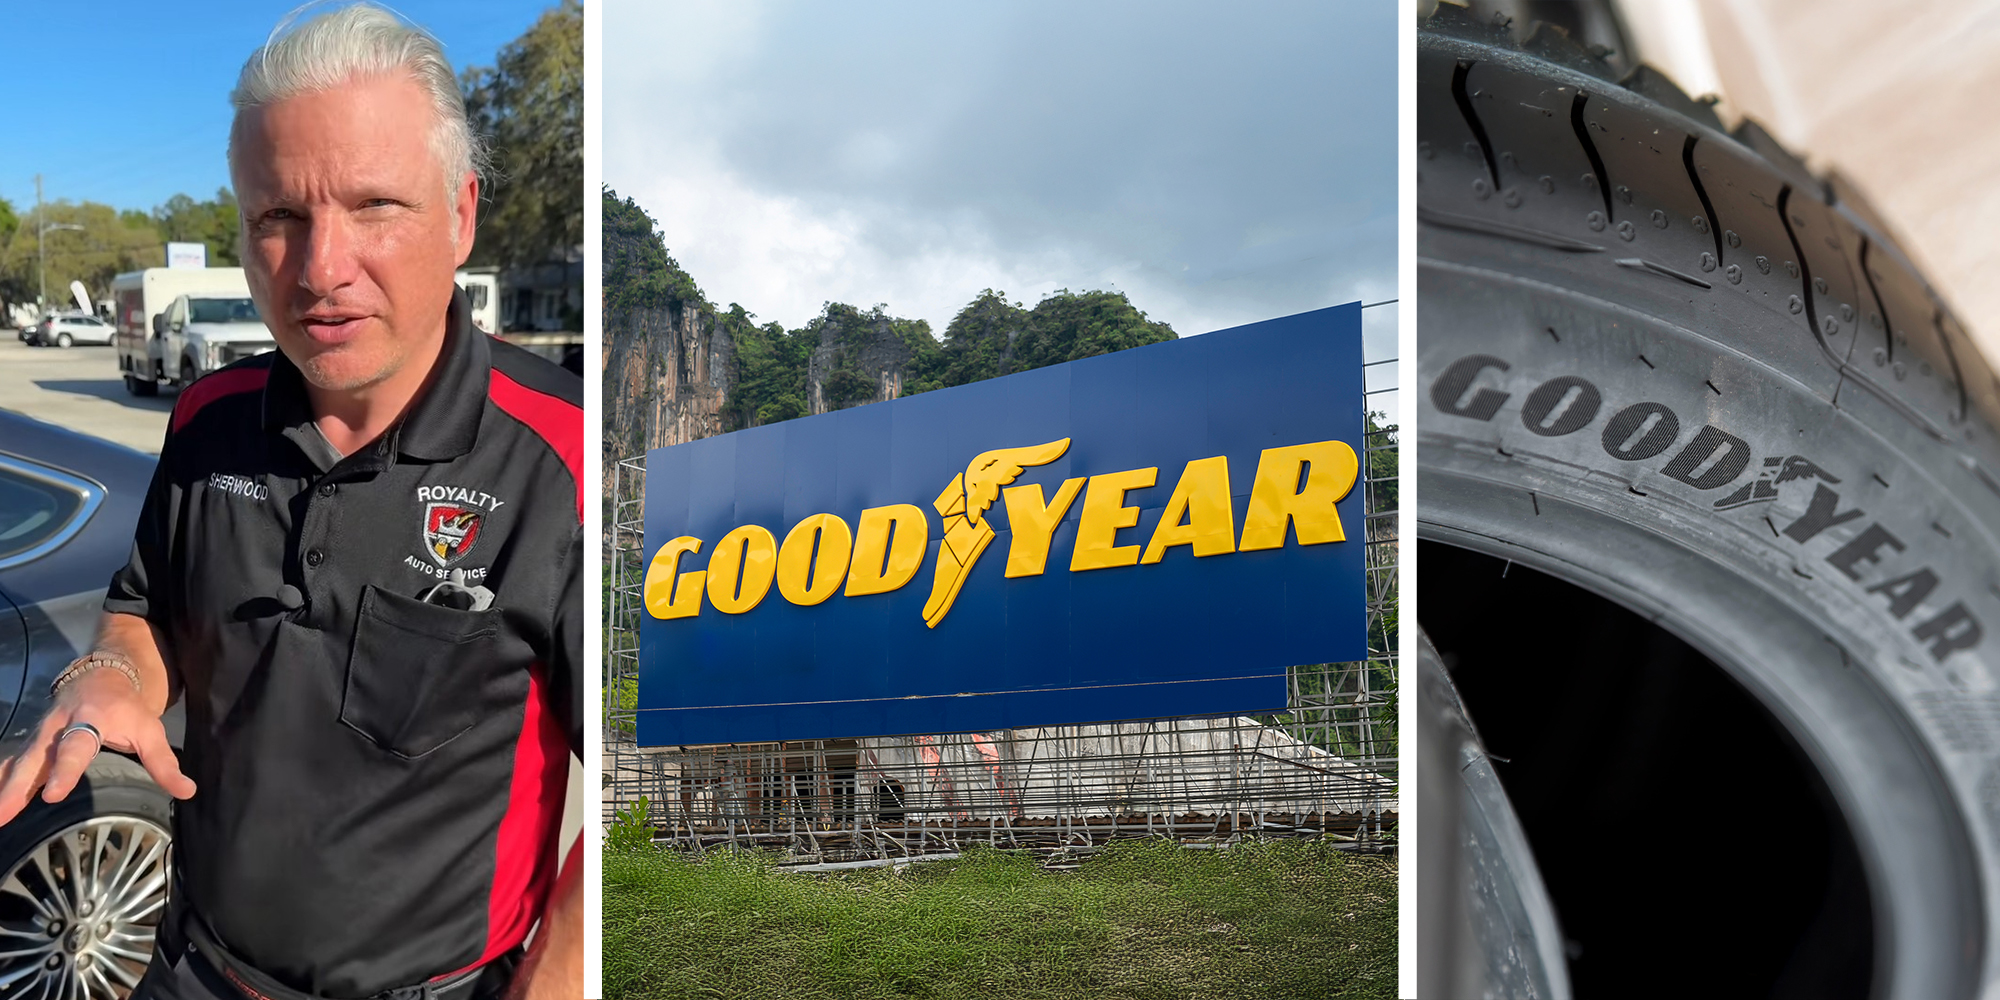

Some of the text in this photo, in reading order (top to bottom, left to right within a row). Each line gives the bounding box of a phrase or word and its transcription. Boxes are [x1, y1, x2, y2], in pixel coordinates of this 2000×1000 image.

[208, 472, 269, 501] SHERWOOD
[417, 485, 505, 512] ROYALTY
[404, 555, 487, 580] AUTO SEVICE
